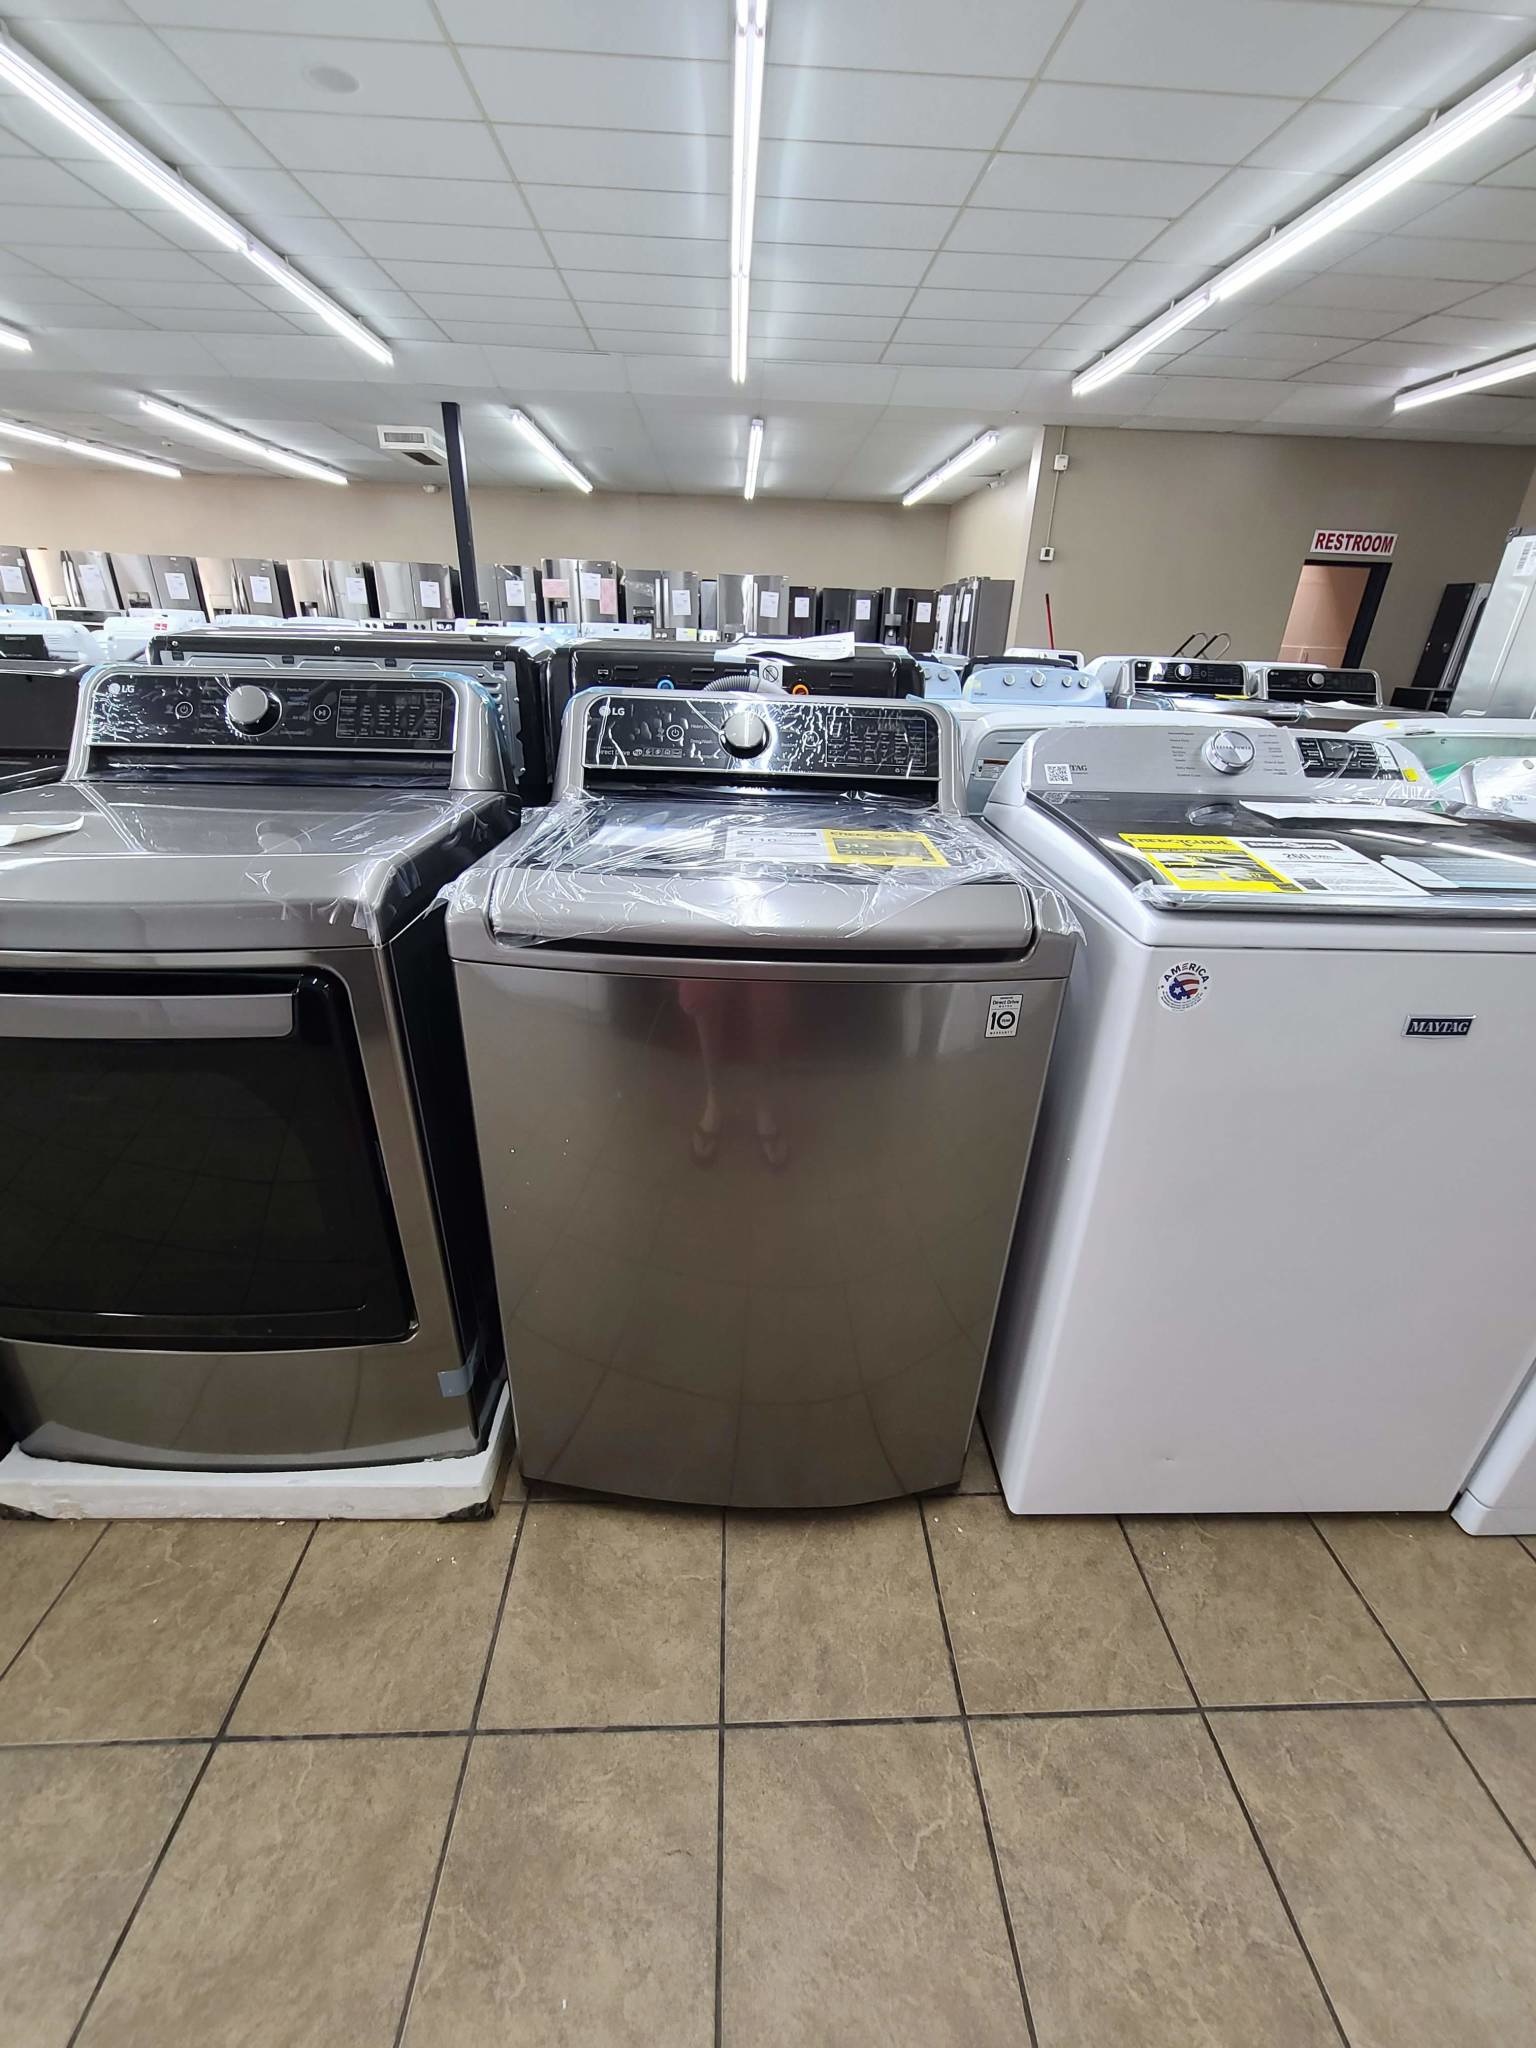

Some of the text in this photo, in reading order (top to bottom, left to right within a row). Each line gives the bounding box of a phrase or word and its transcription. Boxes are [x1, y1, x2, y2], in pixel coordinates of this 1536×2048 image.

[1315, 532, 1394, 553] RESTROOM
[121, 685, 135, 693] LG
[612, 707, 625, 716] LG
[1164, 962, 1210, 983] AMERICA
[991, 1011, 1016, 1030] 10
[1409, 1021, 1469, 1033] MAYTAG
